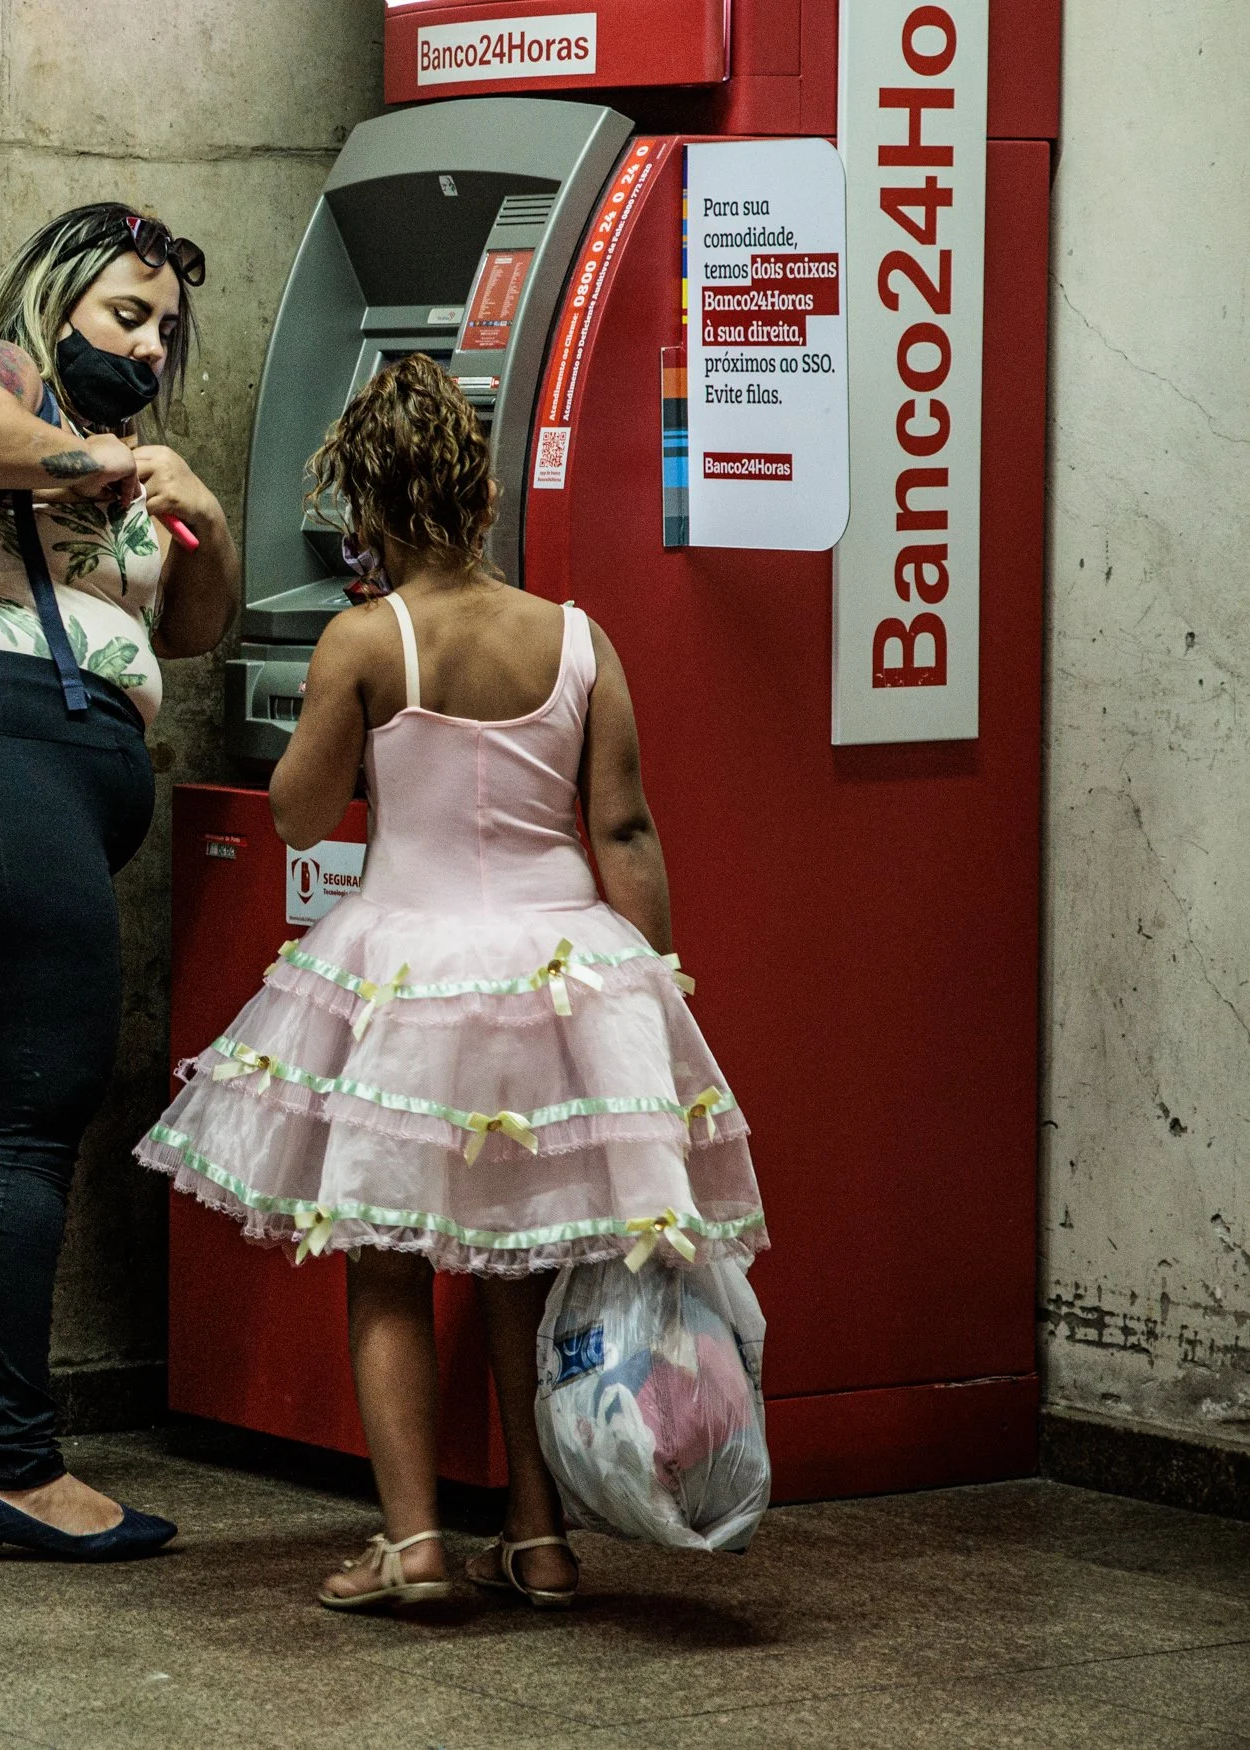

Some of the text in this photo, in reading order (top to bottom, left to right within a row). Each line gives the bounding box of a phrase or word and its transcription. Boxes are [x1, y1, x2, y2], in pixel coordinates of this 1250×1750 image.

[420, 30, 589, 72] Banco24Horas
[621, 198, 635, 220] 0800
[703, 198, 770, 217] Para sua
[703, 226, 798, 250] comodidade,
[592, 260, 610, 300] Auditivo
[704, 257, 837, 280] temos dois caixas
[549, 145, 649, 421] Atendimento ao Cliente: 0800 0 24 0 24 0
[703, 290, 814, 311] Banco24Horas
[578, 300, 597, 347] Deficiente
[704, 320, 803, 345] à sua direita,
[576, 347, 583, 360] ao
[704, 351, 836, 378] próximos ao SSO.
[562, 360, 580, 421] Atendimento
[705, 383, 783, 405] Evite filas.
[704, 457, 791, 475] Banco24Horas
